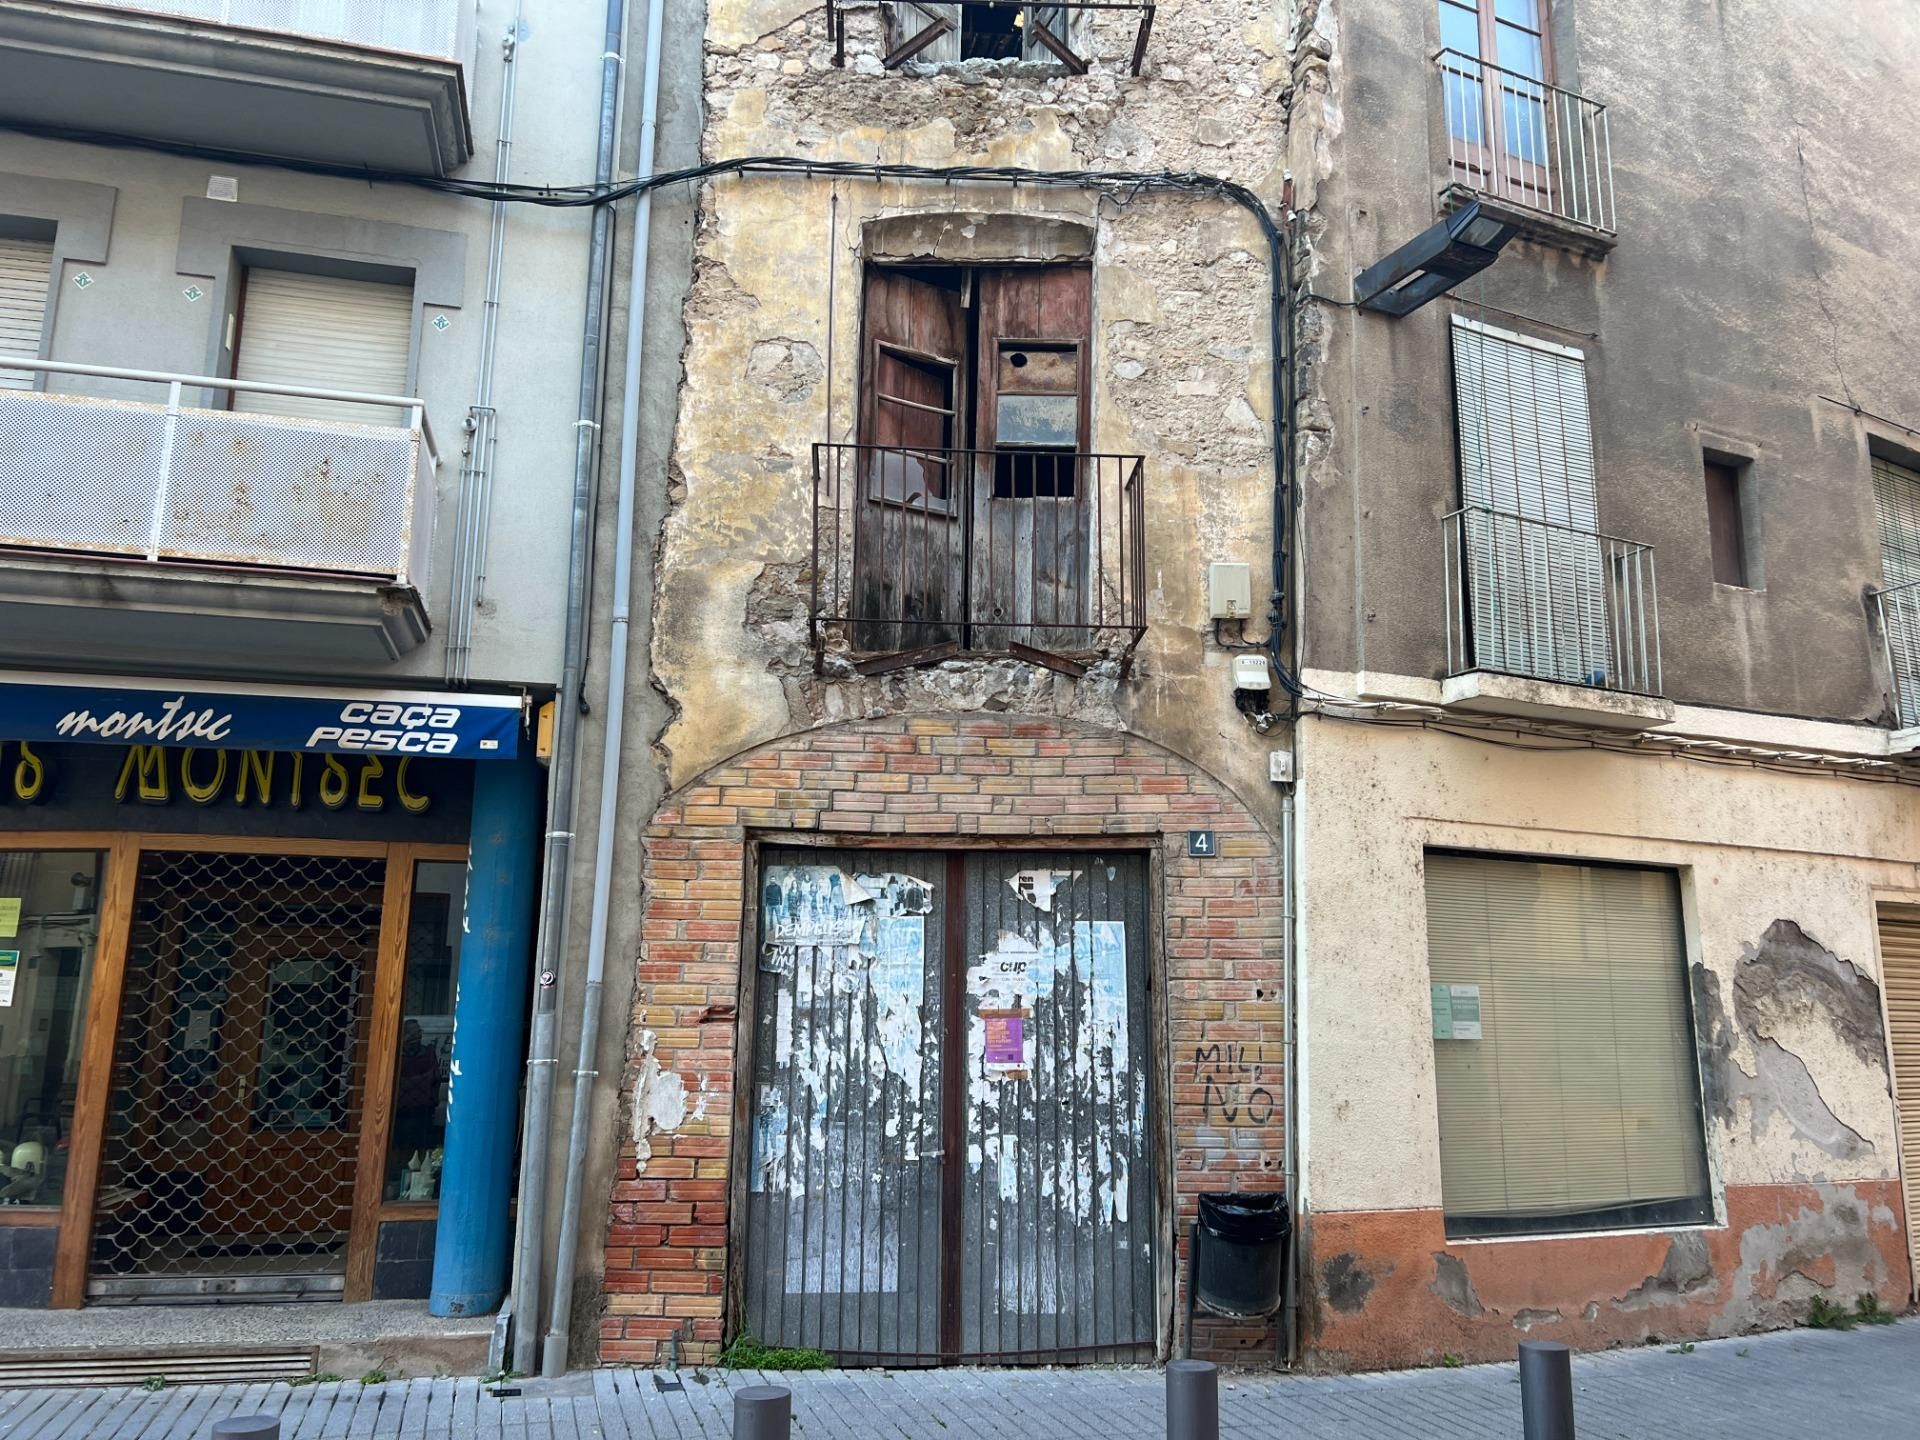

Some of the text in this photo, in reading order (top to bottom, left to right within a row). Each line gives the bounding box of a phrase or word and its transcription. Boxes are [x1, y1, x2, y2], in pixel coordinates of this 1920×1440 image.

[56, 696, 232, 741] montsec
[1195, 833, 1209, 852] 4
[1203, 1075, 1274, 1125] NO
